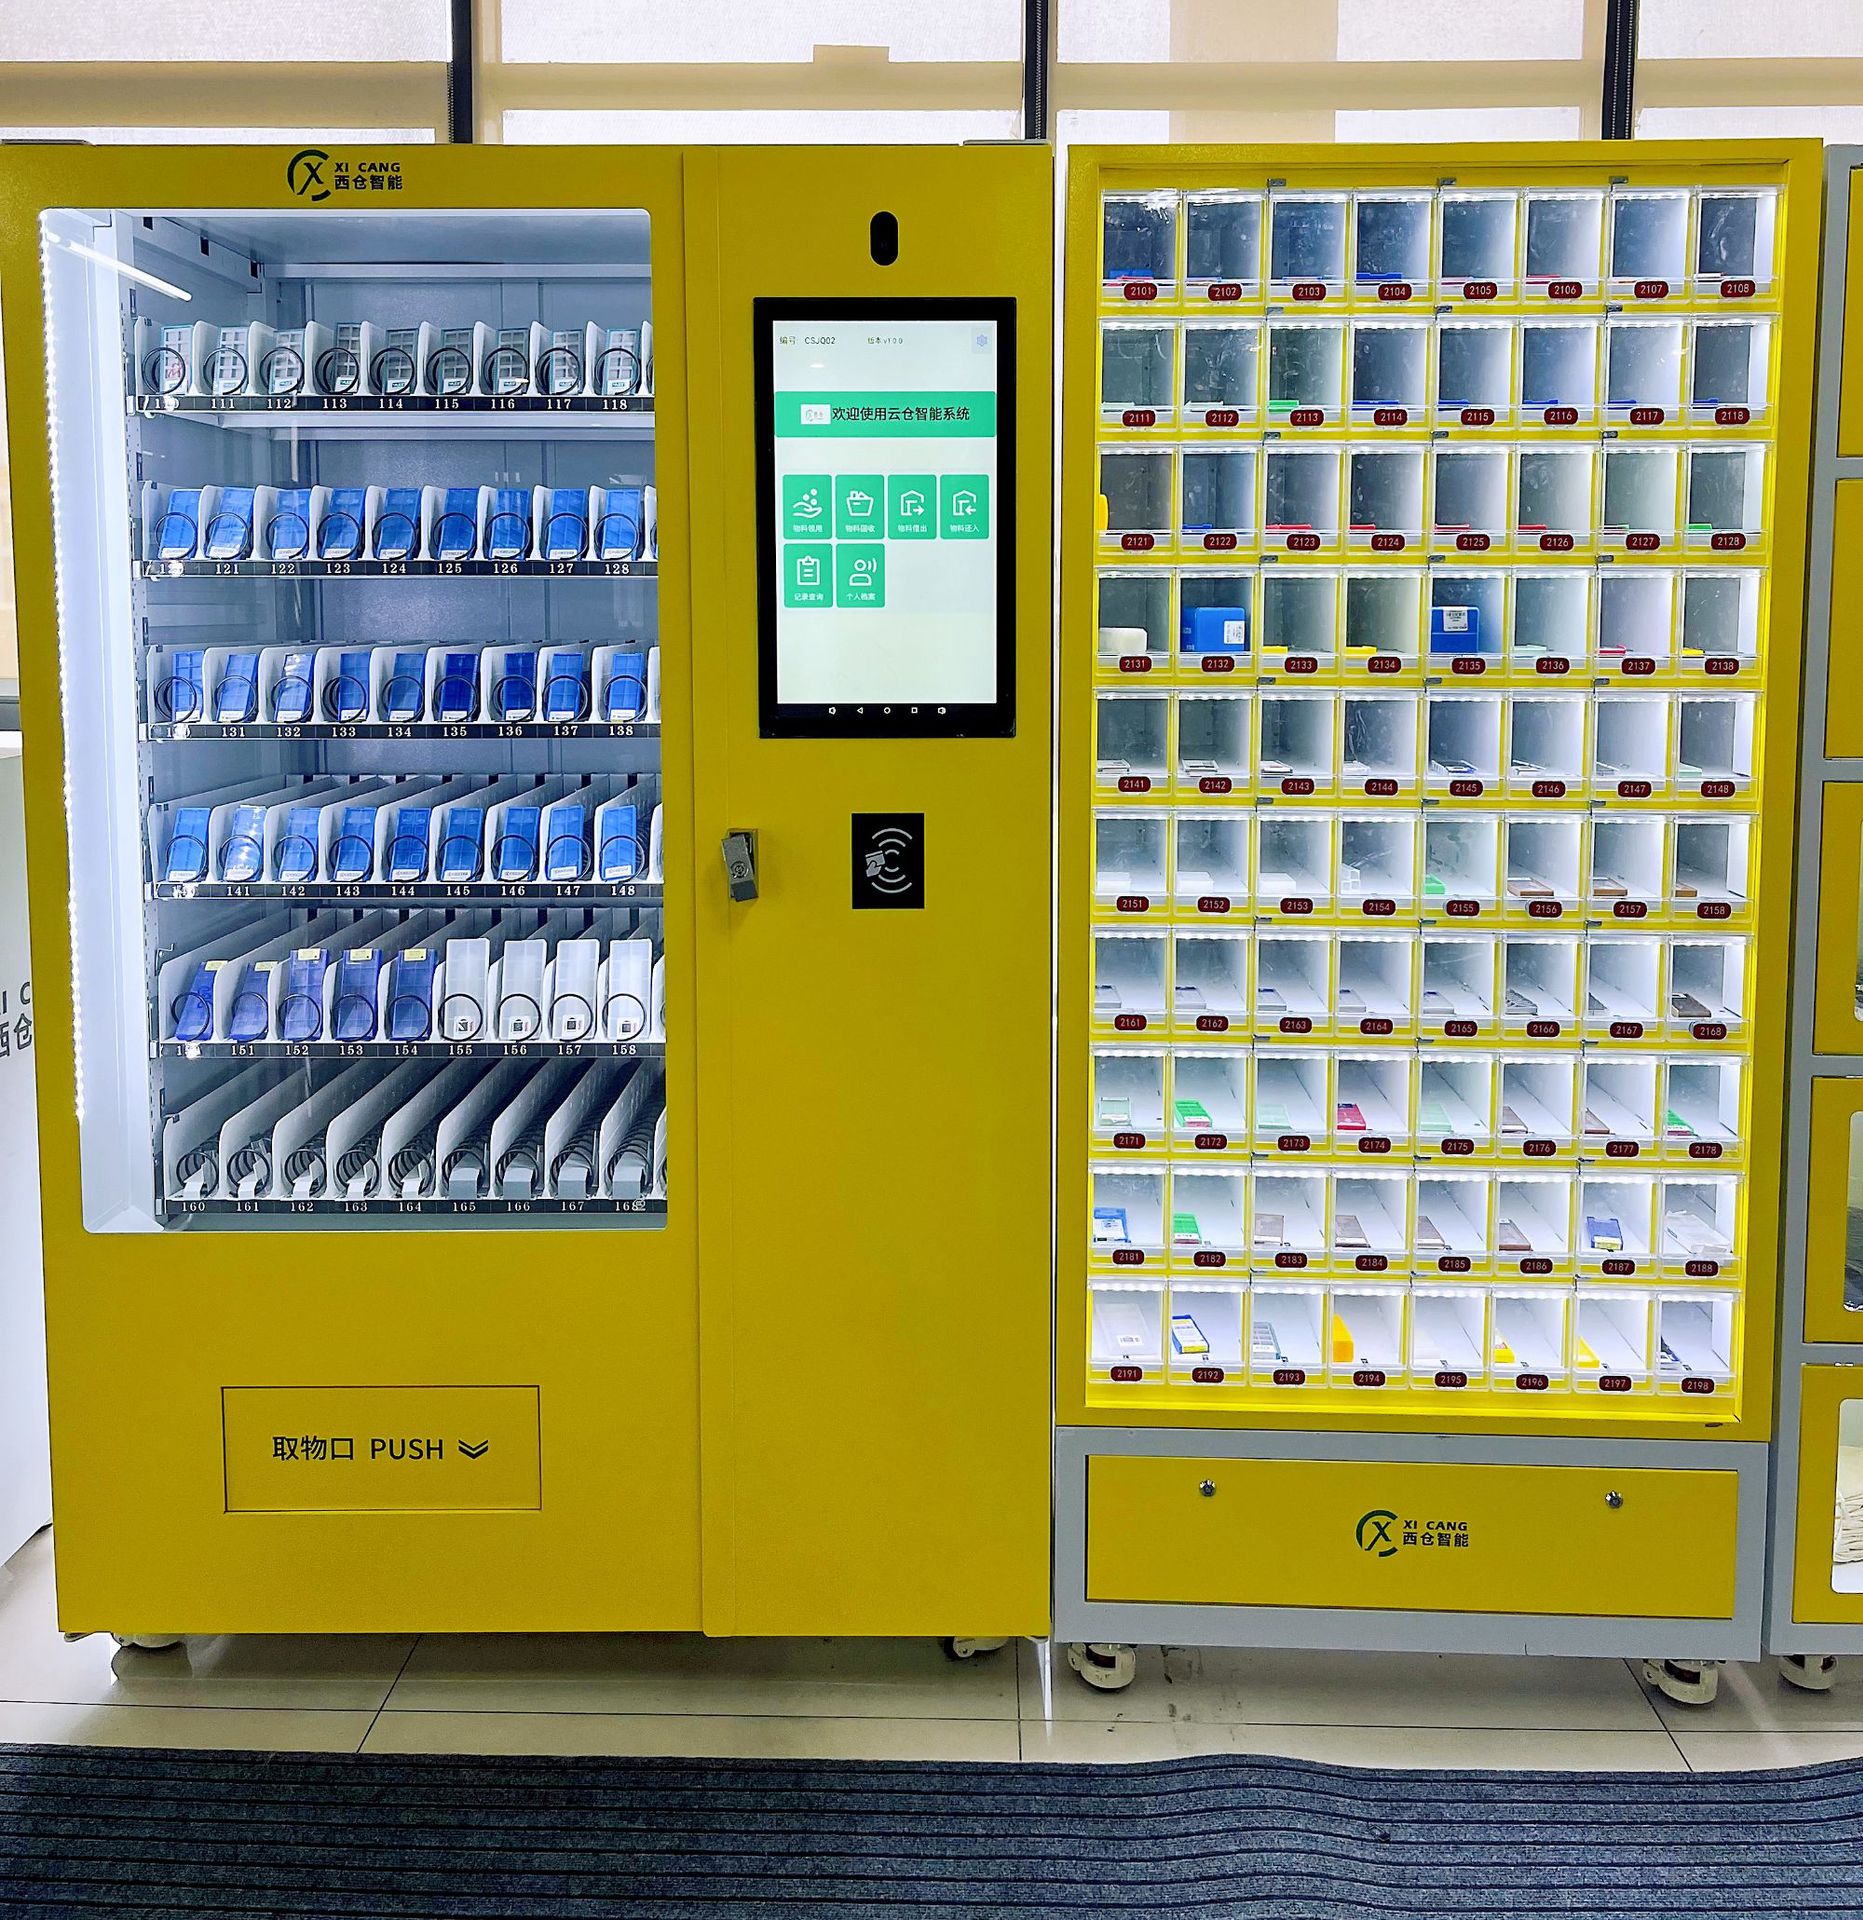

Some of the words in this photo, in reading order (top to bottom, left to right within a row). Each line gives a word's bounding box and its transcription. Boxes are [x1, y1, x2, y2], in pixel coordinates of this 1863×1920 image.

[334, 162, 349, 173] XI
[358, 162, 401, 173] CANG
[334, 174, 403, 190] 西仓智能
[1130, 286, 1150, 296] 2101
[1214, 286, 1237, 297] 2102
[1298, 286, 1320, 297] 2103
[1384, 286, 1406, 297] 2104
[1469, 285, 1492, 296] 2105
[1554, 285, 1577, 295] 2106
[1640, 284, 1663, 295] 2107
[1727, 283, 1750, 294] 2108
[804, 336, 836, 345] CSJQ02
[211, 398, 235, 409] 111
[267, 398, 292, 409] 112
[323, 398, 347, 409] 113
[379, 398, 403, 409] 114
[435, 398, 459, 409] 115
[491, 398, 515, 409] 116
[547, 398, 572, 410] 117
[602, 398, 628, 410] 118
[832, 406, 970, 421] 欢迎使用云仓智能系统
[1129, 413, 1150, 423] 2111
[1211, 412, 1234, 423] 2112
[1296, 412, 1319, 423] 2113
[1380, 412, 1402, 422] 2114
[1467, 412, 1489, 422] 2115
[1550, 410, 1573, 421] 2116
[1635, 411, 1659, 421] 2117
[1721, 410, 1744, 421] 2118
[1127, 536, 1148, 546] 2121
[1209, 536, 1231, 546] 2122
[1293, 537, 1316, 547] 2123
[1377, 537, 1399, 547] 2124
[1462, 537, 1485, 547] 2125
[1546, 537, 1569, 547] 2126
[1632, 536, 1655, 547] 2127
[1717, 536, 1740, 546] 2128
[215, 563, 239, 575] 121
[271, 563, 295, 575] 122
[326, 562, 351, 574] 123
[382, 562, 406, 574] 124
[438, 562, 462, 574] 125
[494, 562, 518, 574] 126
[549, 562, 574, 574] 127
[605, 563, 630, 575] 128
[1124, 659, 1145, 669] 2131
[1207, 659, 1229, 669] 2132
[1290, 660, 1312, 670] 2133
[1373, 659, 1395, 670] 2134
[1458, 660, 1481, 671] 2135
[1542, 660, 1565, 670] 2136
[1628, 661, 1650, 671] 2137
[1712, 661, 1734, 671] 2138
[222, 726, 245, 738] 131
[277, 726, 301, 737] 132
[332, 726, 356, 737] 133
[388, 726, 412, 737] 134
[443, 726, 467, 737] 135
[498, 725, 523, 737] 136
[554, 725, 578, 736] 137
[609, 725, 634, 736] 138
[1123, 779, 1144, 789] 2141
[1204, 780, 1226, 790] 2142
[1288, 781, 1310, 791] 2143
[1371, 782, 1393, 792] 2144
[1455, 783, 1477, 793] 2145
[1537, 784, 1560, 794] 2146
[1624, 784, 1646, 794] 2147
[1707, 784, 1729, 794] 2148
[227, 885, 250, 897] 141
[281, 885, 305, 897] 142
[336, 885, 360, 897] 143
[391, 885, 415, 896] 144
[446, 885, 470, 896] 145
[501, 885, 525, 896] 146
[556, 885, 581, 896] 147
[611, 885, 636, 896] 148
[1122, 899, 1142, 909] 2151
[1203, 899, 1225, 910] 2152
[1287, 901, 1309, 911] 2153
[1369, 902, 1390, 912] 2154
[1452, 903, 1474, 913] 2155
[1535, 904, 1557, 914] 2156
[1619, 904, 1642, 914] 2157
[1703, 905, 1726, 915] 2158
[1120, 1017, 1140, 1027] 2161
[1201, 1018, 1223, 1028] 2162
[1285, 1020, 1306, 1030] 2163
[1366, 1021, 1387, 1031] 2164
[1451, 1023, 1473, 1033] 2165
[1532, 1024, 1555, 1034] 2166
[1616, 1025, 1638, 1035] 2167
[1700, 1026, 1722, 1036] 2168
[231, 1044, 254, 1056] 151
[285, 1044, 309, 1056] 152
[339, 1044, 364, 1056] 153
[394, 1044, 418, 1056] 154
[449, 1044, 473, 1056] 155
[503, 1044, 527, 1056] 156
[558, 1044, 582, 1055] 157
[612, 1044, 637, 1056] 158
[1119, 1136, 1139, 1145] 2171
[1200, 1137, 1222, 1146] 2172
[1283, 1138, 1304, 1148] 2173
[1364, 1140, 1385, 1150] 2174
[1447, 1142, 1468, 1152] 2175
[1529, 1143, 1551, 1153] 2176
[1612, 1144, 1634, 1154] 2177
[1695, 1145, 1717, 1155] 2178
[182, 1201, 206, 1212] 160
[236, 1201, 259, 1212] 161
[291, 1202, 314, 1212] 162
[345, 1202, 368, 1212] 163
[399, 1201, 422, 1212] 164
[453, 1201, 476, 1212] 165
[507, 1201, 530, 1212] 166
[561, 1201, 585, 1212] 167
[1119, 1252, 1139, 1261] 2181
[1200, 1254, 1221, 1264] 2182
[1281, 1255, 1303, 1264] 2183
[1362, 1258, 1383, 1267] 2184
[1444, 1259, 1466, 1269] 2185
[1526, 1261, 1548, 1271] 2186
[1608, 1262, 1630, 1272] 2187
[1691, 1263, 1713, 1273] 2188
[1117, 1369, 1137, 1378] 2191
[1197, 1370, 1219, 1380] 2192
[1278, 1372, 1300, 1382] 2193
[1358, 1373, 1380, 1383] 2194
[1440, 1375, 1462, 1385] 2195
[1522, 1377, 1544, 1387] 2196
[1604, 1378, 1626, 1388] 2197
[1687, 1380, 1709, 1391] 2198
[272, 1435, 354, 1461] 取物口
[371, 1438, 443, 1460] PUSH
[1402, 1519, 1418, 1530] XI
[1426, 1520, 1468, 1532] CANG
[1402, 1531, 1469, 1548] 西仓智能
